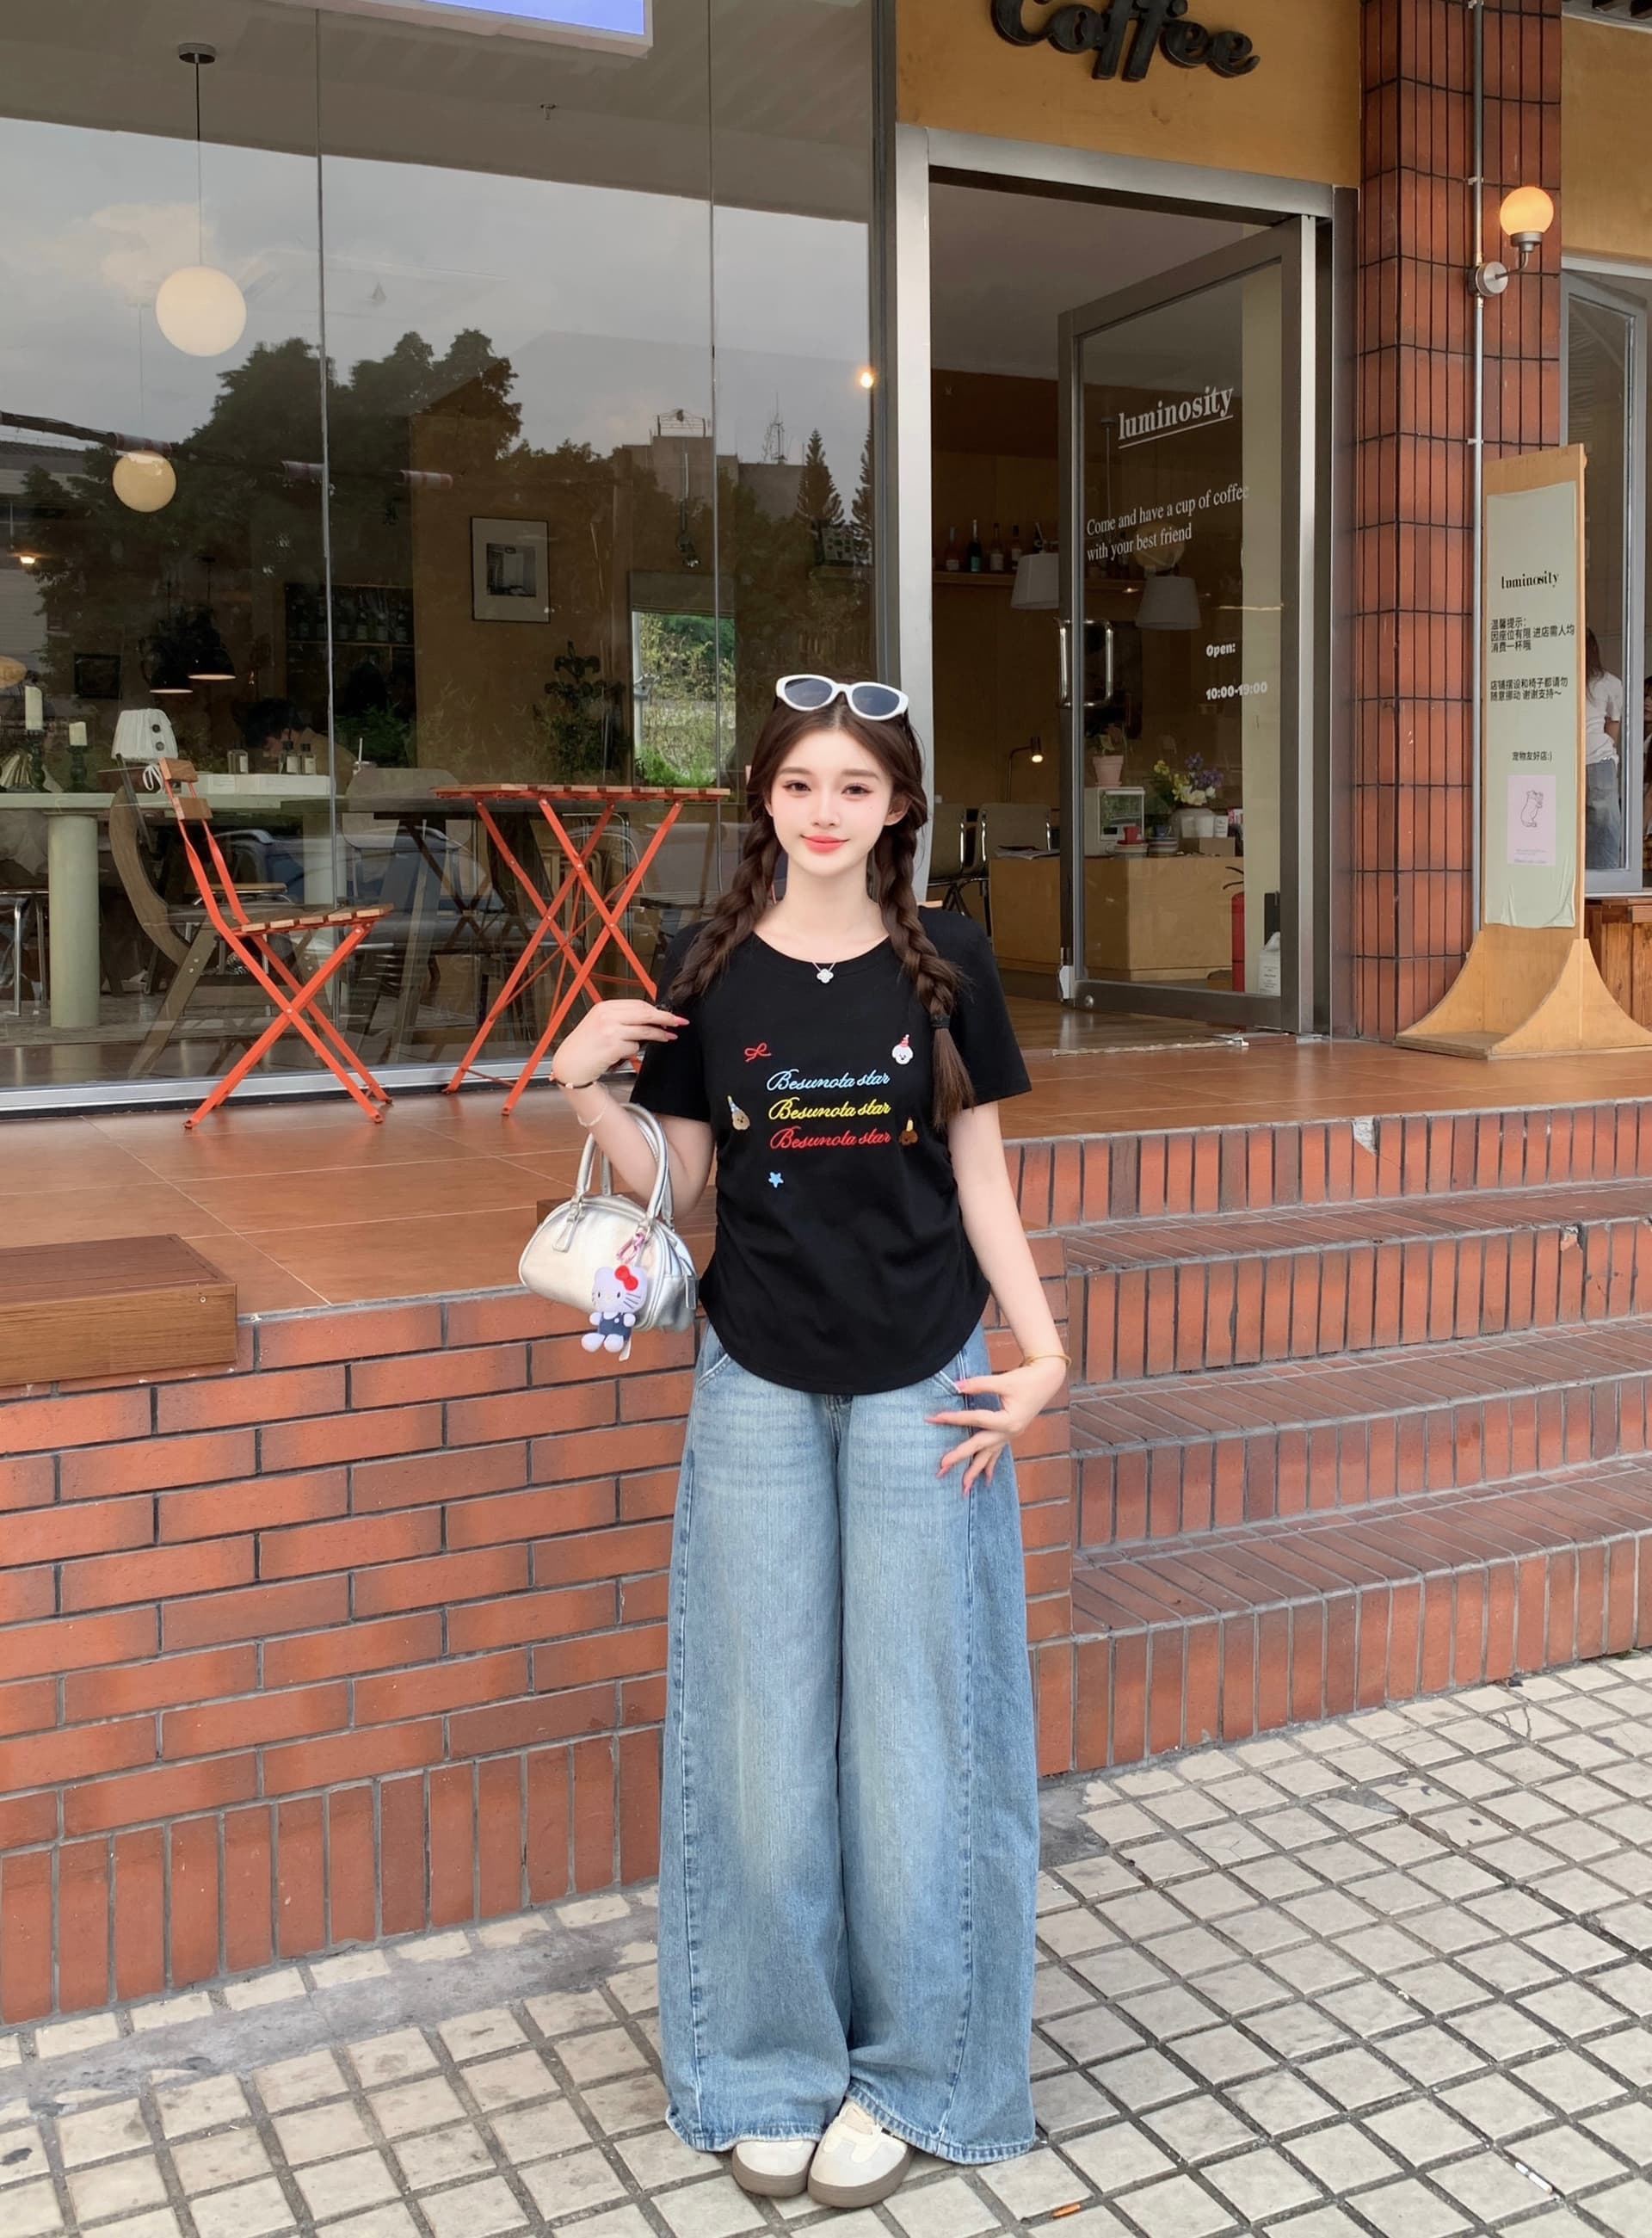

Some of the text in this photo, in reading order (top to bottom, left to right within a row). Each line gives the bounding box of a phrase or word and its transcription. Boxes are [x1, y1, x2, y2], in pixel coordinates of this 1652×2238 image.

[1119, 386, 1234, 441] luminosity
[1087, 483, 1249, 536] Come and have a cup of coffee
[1087, 522, 1193, 562] with your best friend
[1501, 570, 1560, 589] luminosity
[1491, 628, 1532, 642] 因座位有限
[1205, 643, 1236, 658] Open:
[857, 1069, 891, 1086] star
[858, 1098, 891, 1116] star
[858, 1127, 891, 1145] star
